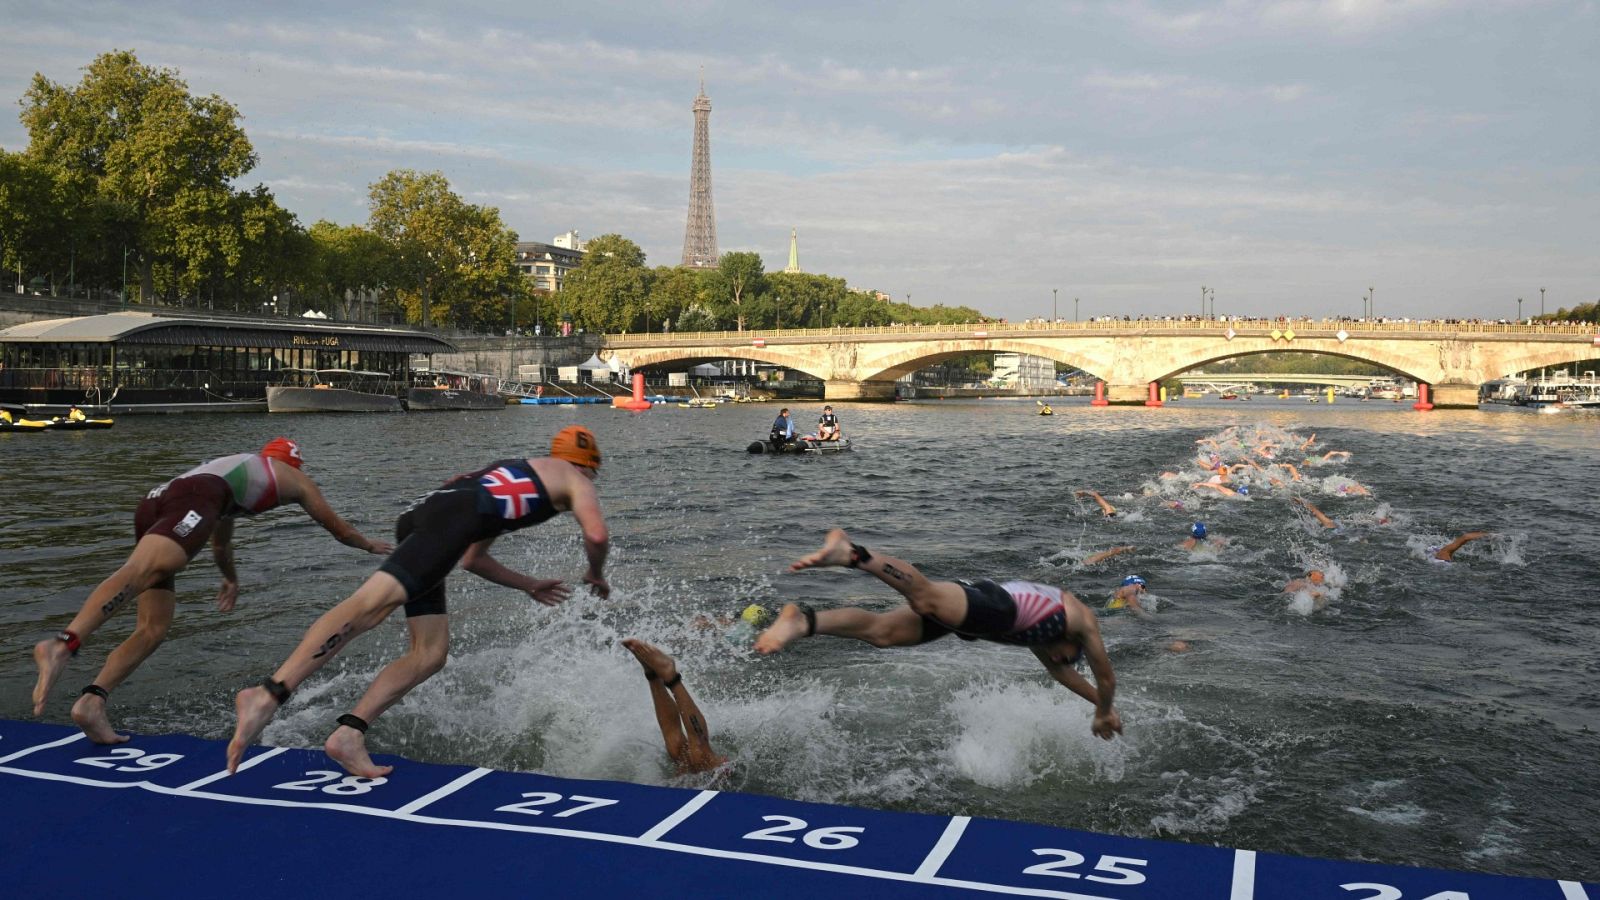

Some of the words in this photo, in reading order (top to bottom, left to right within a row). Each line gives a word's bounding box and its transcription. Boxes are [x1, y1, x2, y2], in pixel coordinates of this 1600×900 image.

[72, 748, 185, 772] 29
[272, 770, 389, 795] 28
[493, 791, 620, 818] 27
[741, 815, 866, 850] 26
[1022, 848, 1148, 885] 25
